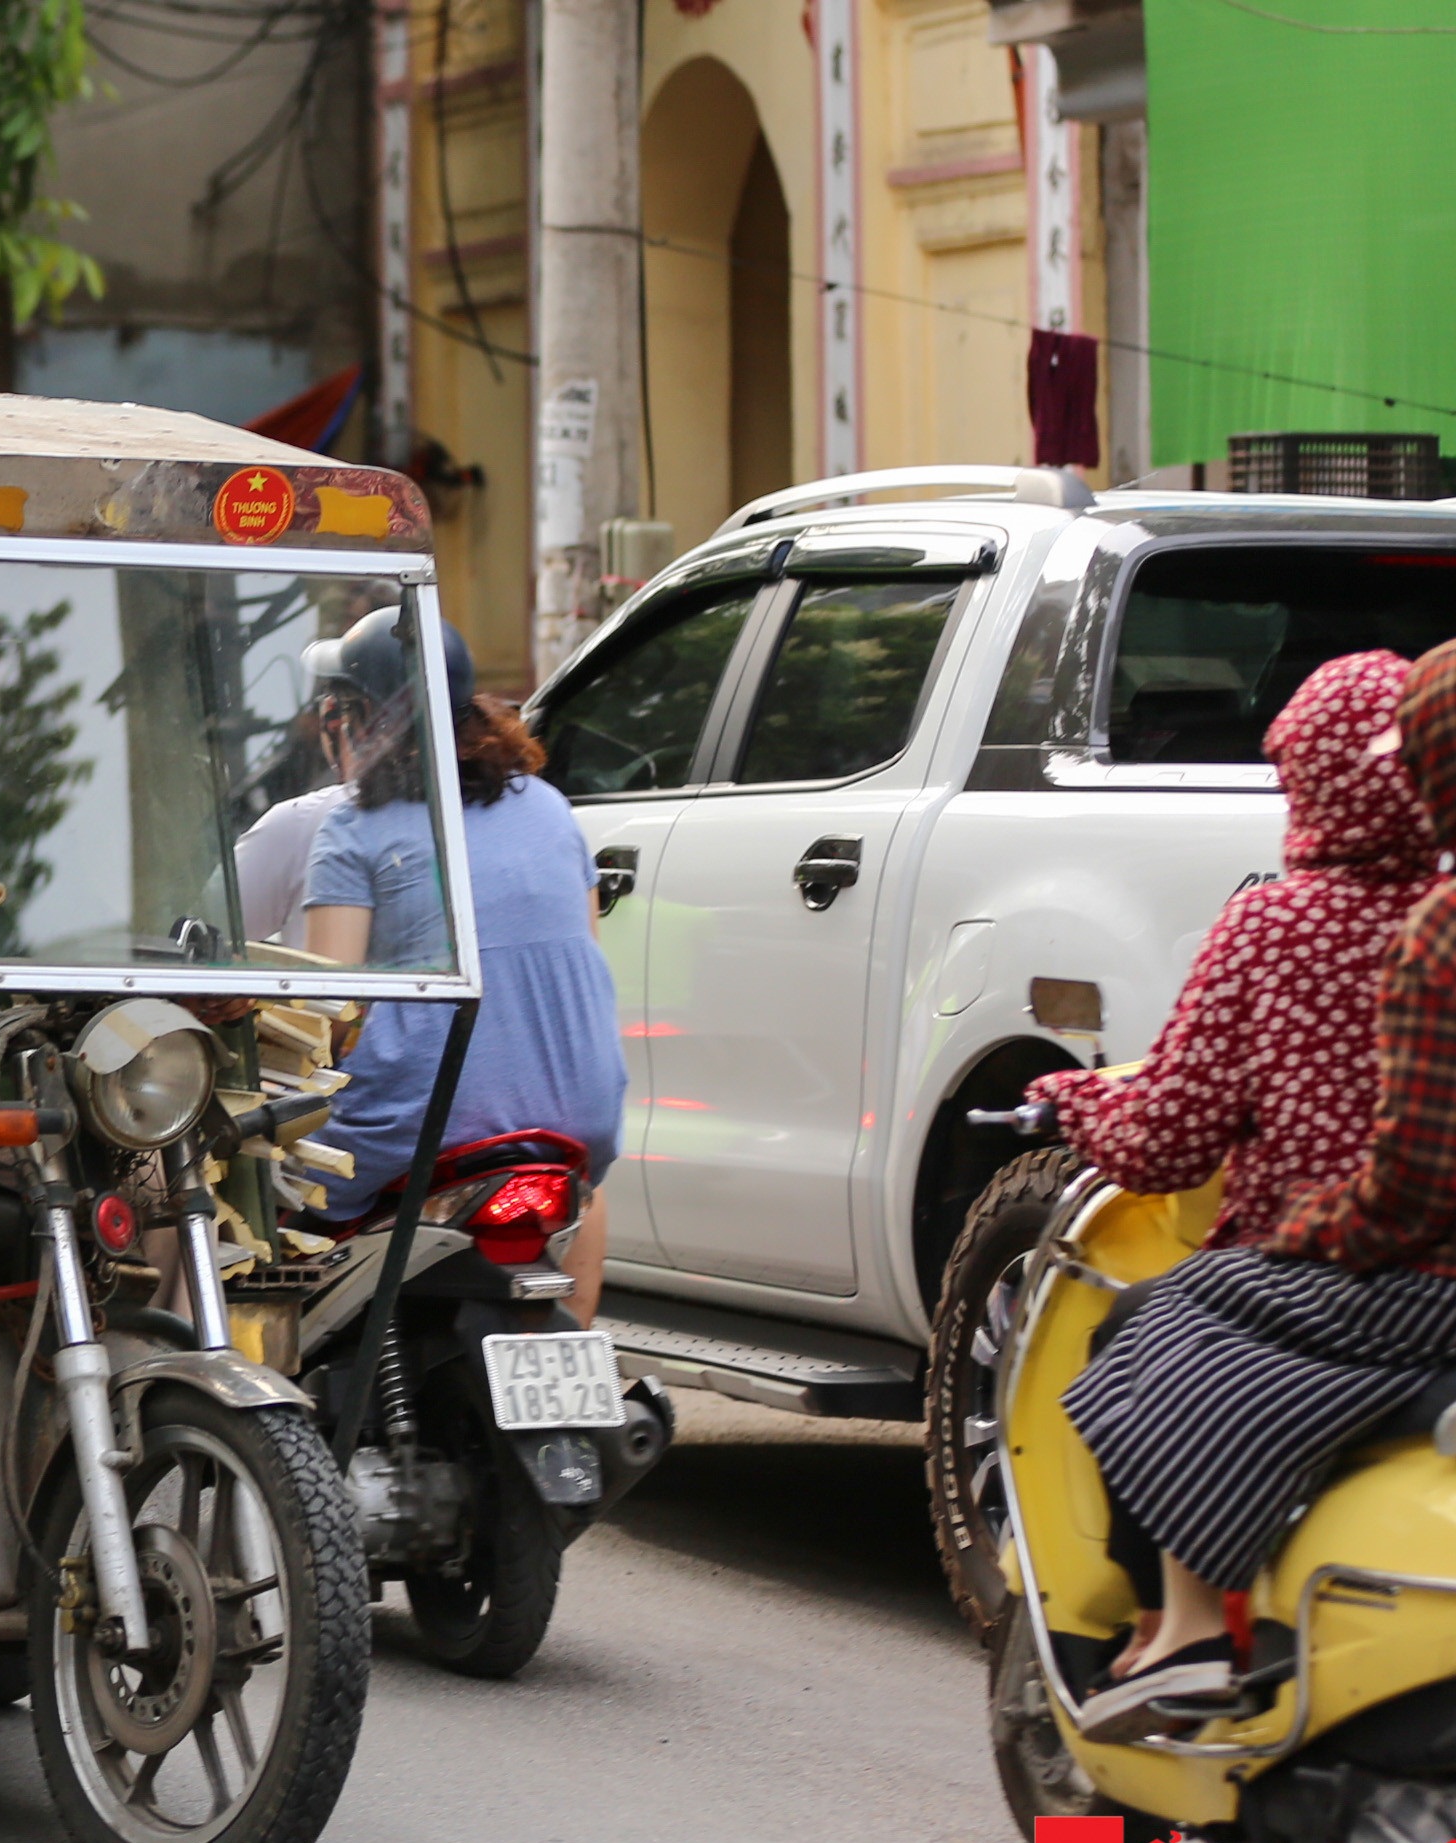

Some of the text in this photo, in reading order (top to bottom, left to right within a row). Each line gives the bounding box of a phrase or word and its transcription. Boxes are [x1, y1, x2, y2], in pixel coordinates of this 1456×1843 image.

[239, 515, 266, 528] BINH
[503, 1340, 595, 1380] 29-B1
[504, 1382, 612, 1422] 185.29
